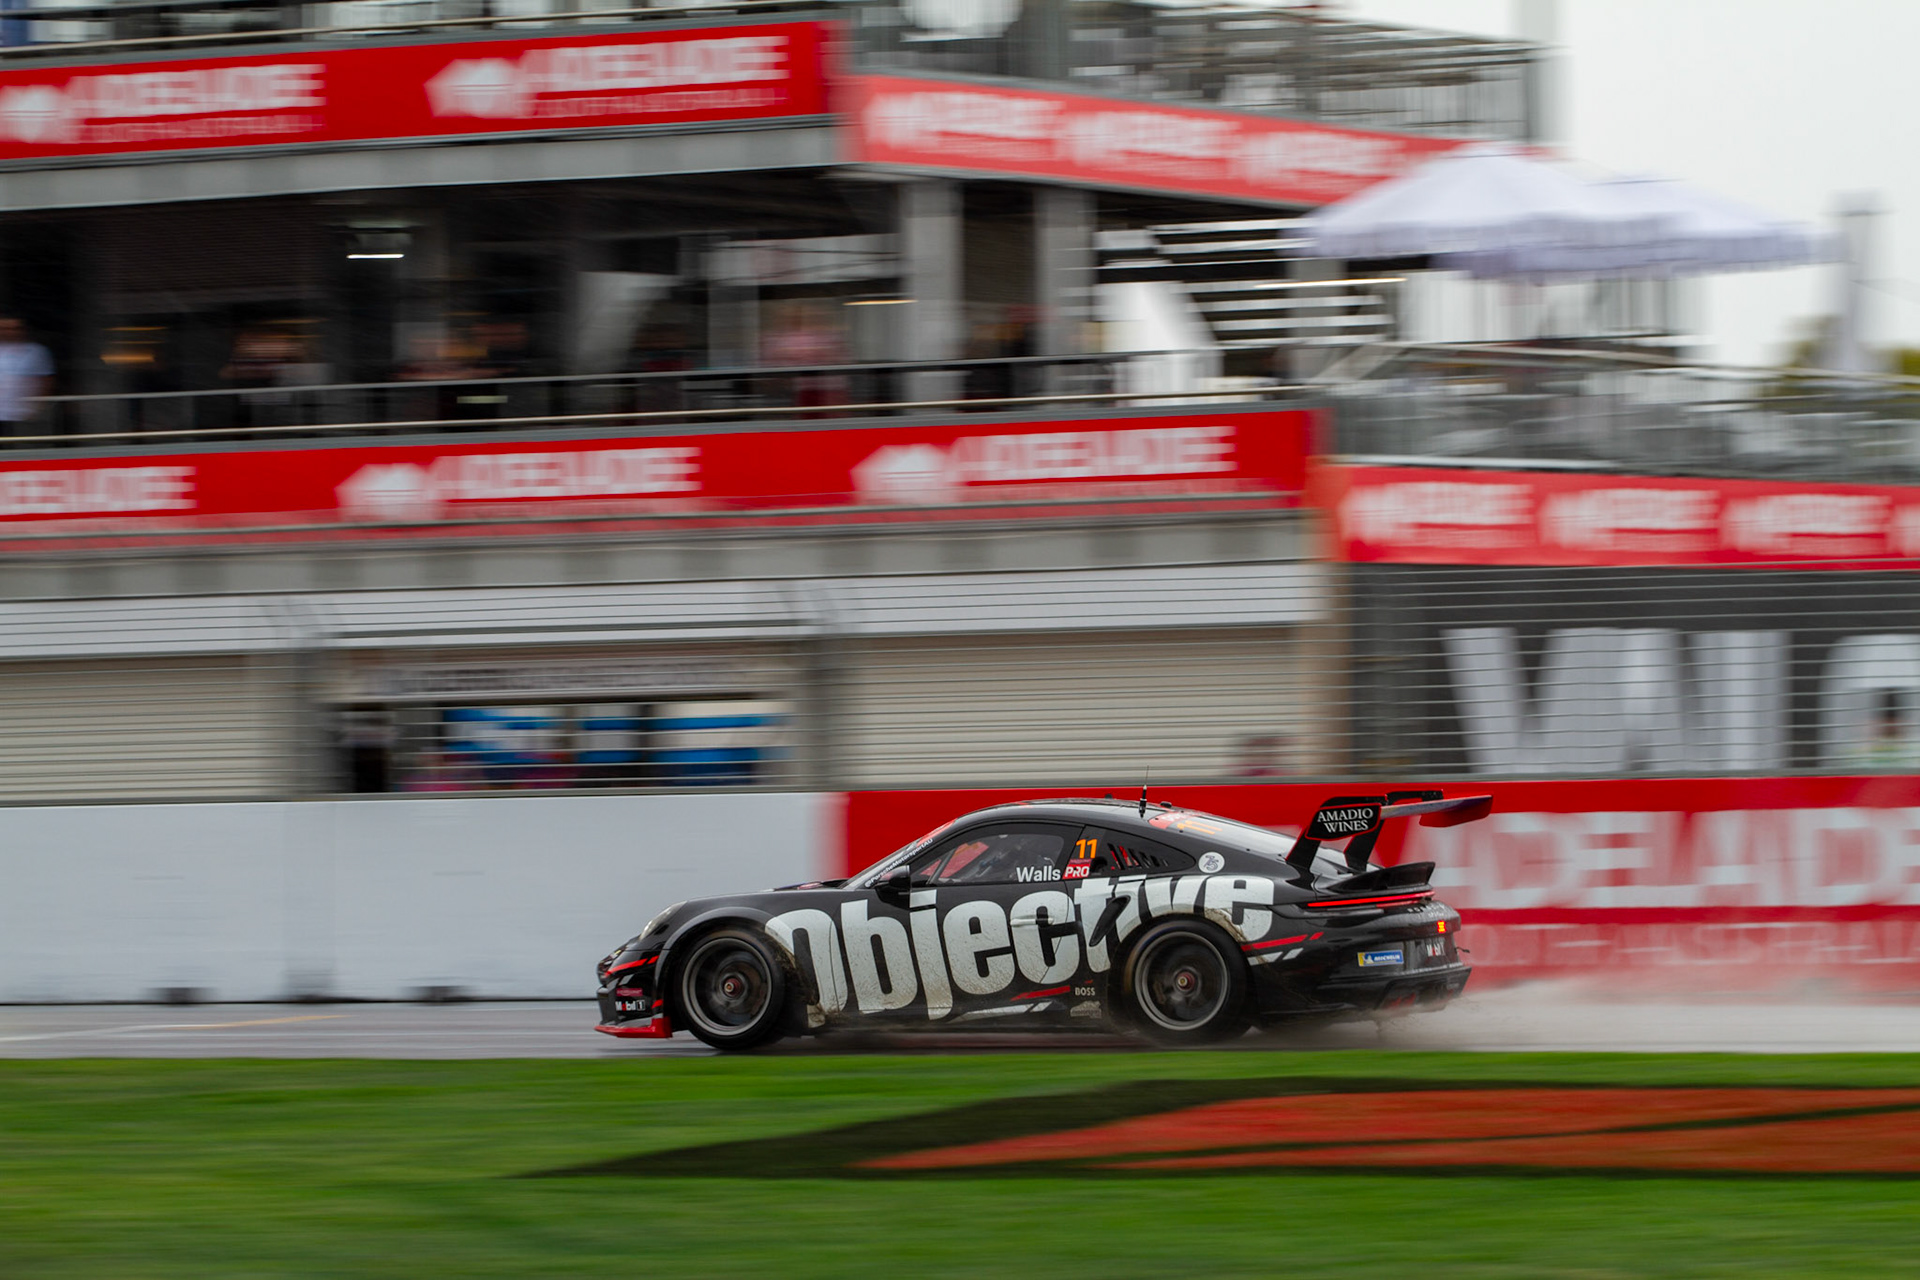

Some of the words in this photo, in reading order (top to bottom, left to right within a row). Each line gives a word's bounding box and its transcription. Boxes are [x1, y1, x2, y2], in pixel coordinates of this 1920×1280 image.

[1317, 808, 1374, 822] AMADIO
[1323, 820, 1369, 833] WINES
[1076, 838, 1098, 859] 11
[1016, 865, 1061, 882] Walls
[1064, 866, 1090, 878] PRO
[1074, 987, 1096, 996] BOSS
